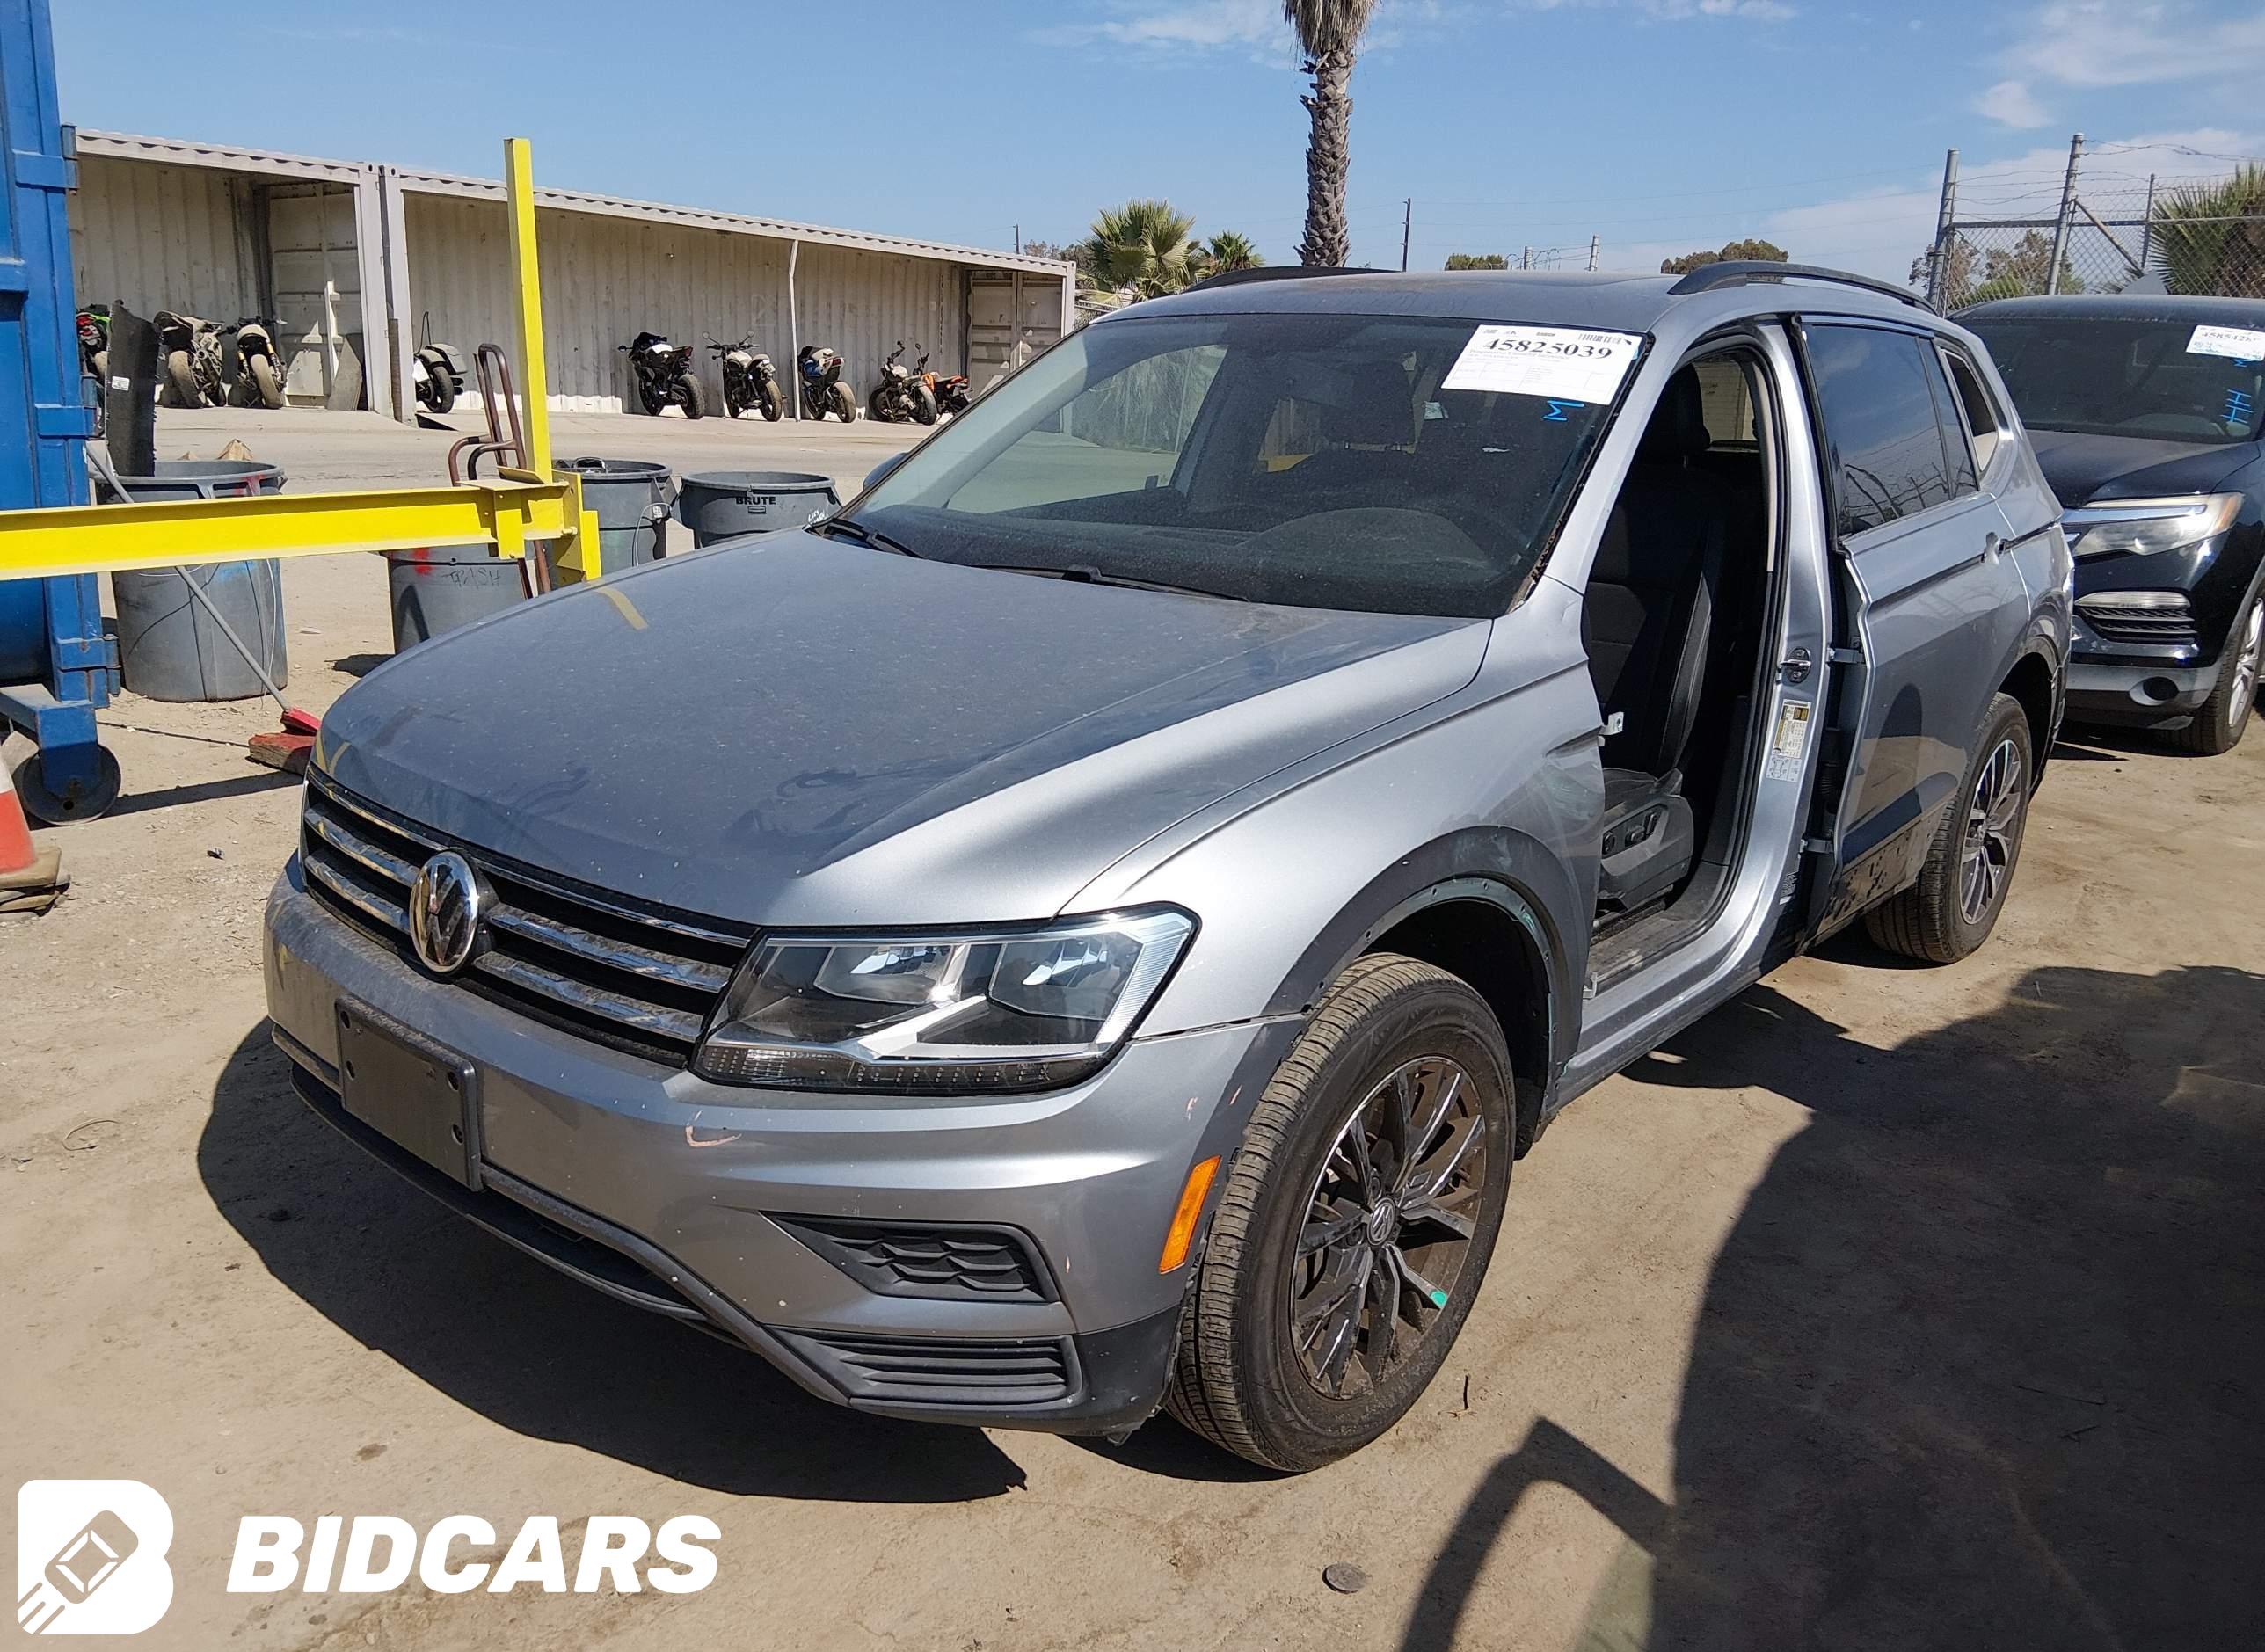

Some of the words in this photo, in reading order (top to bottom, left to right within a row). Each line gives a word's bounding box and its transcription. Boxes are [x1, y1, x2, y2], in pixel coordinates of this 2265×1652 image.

[1483, 338, 1613, 360] 45825039
[735, 496, 776, 505] BRUTE
[441, 567, 500, 587] TRASH
